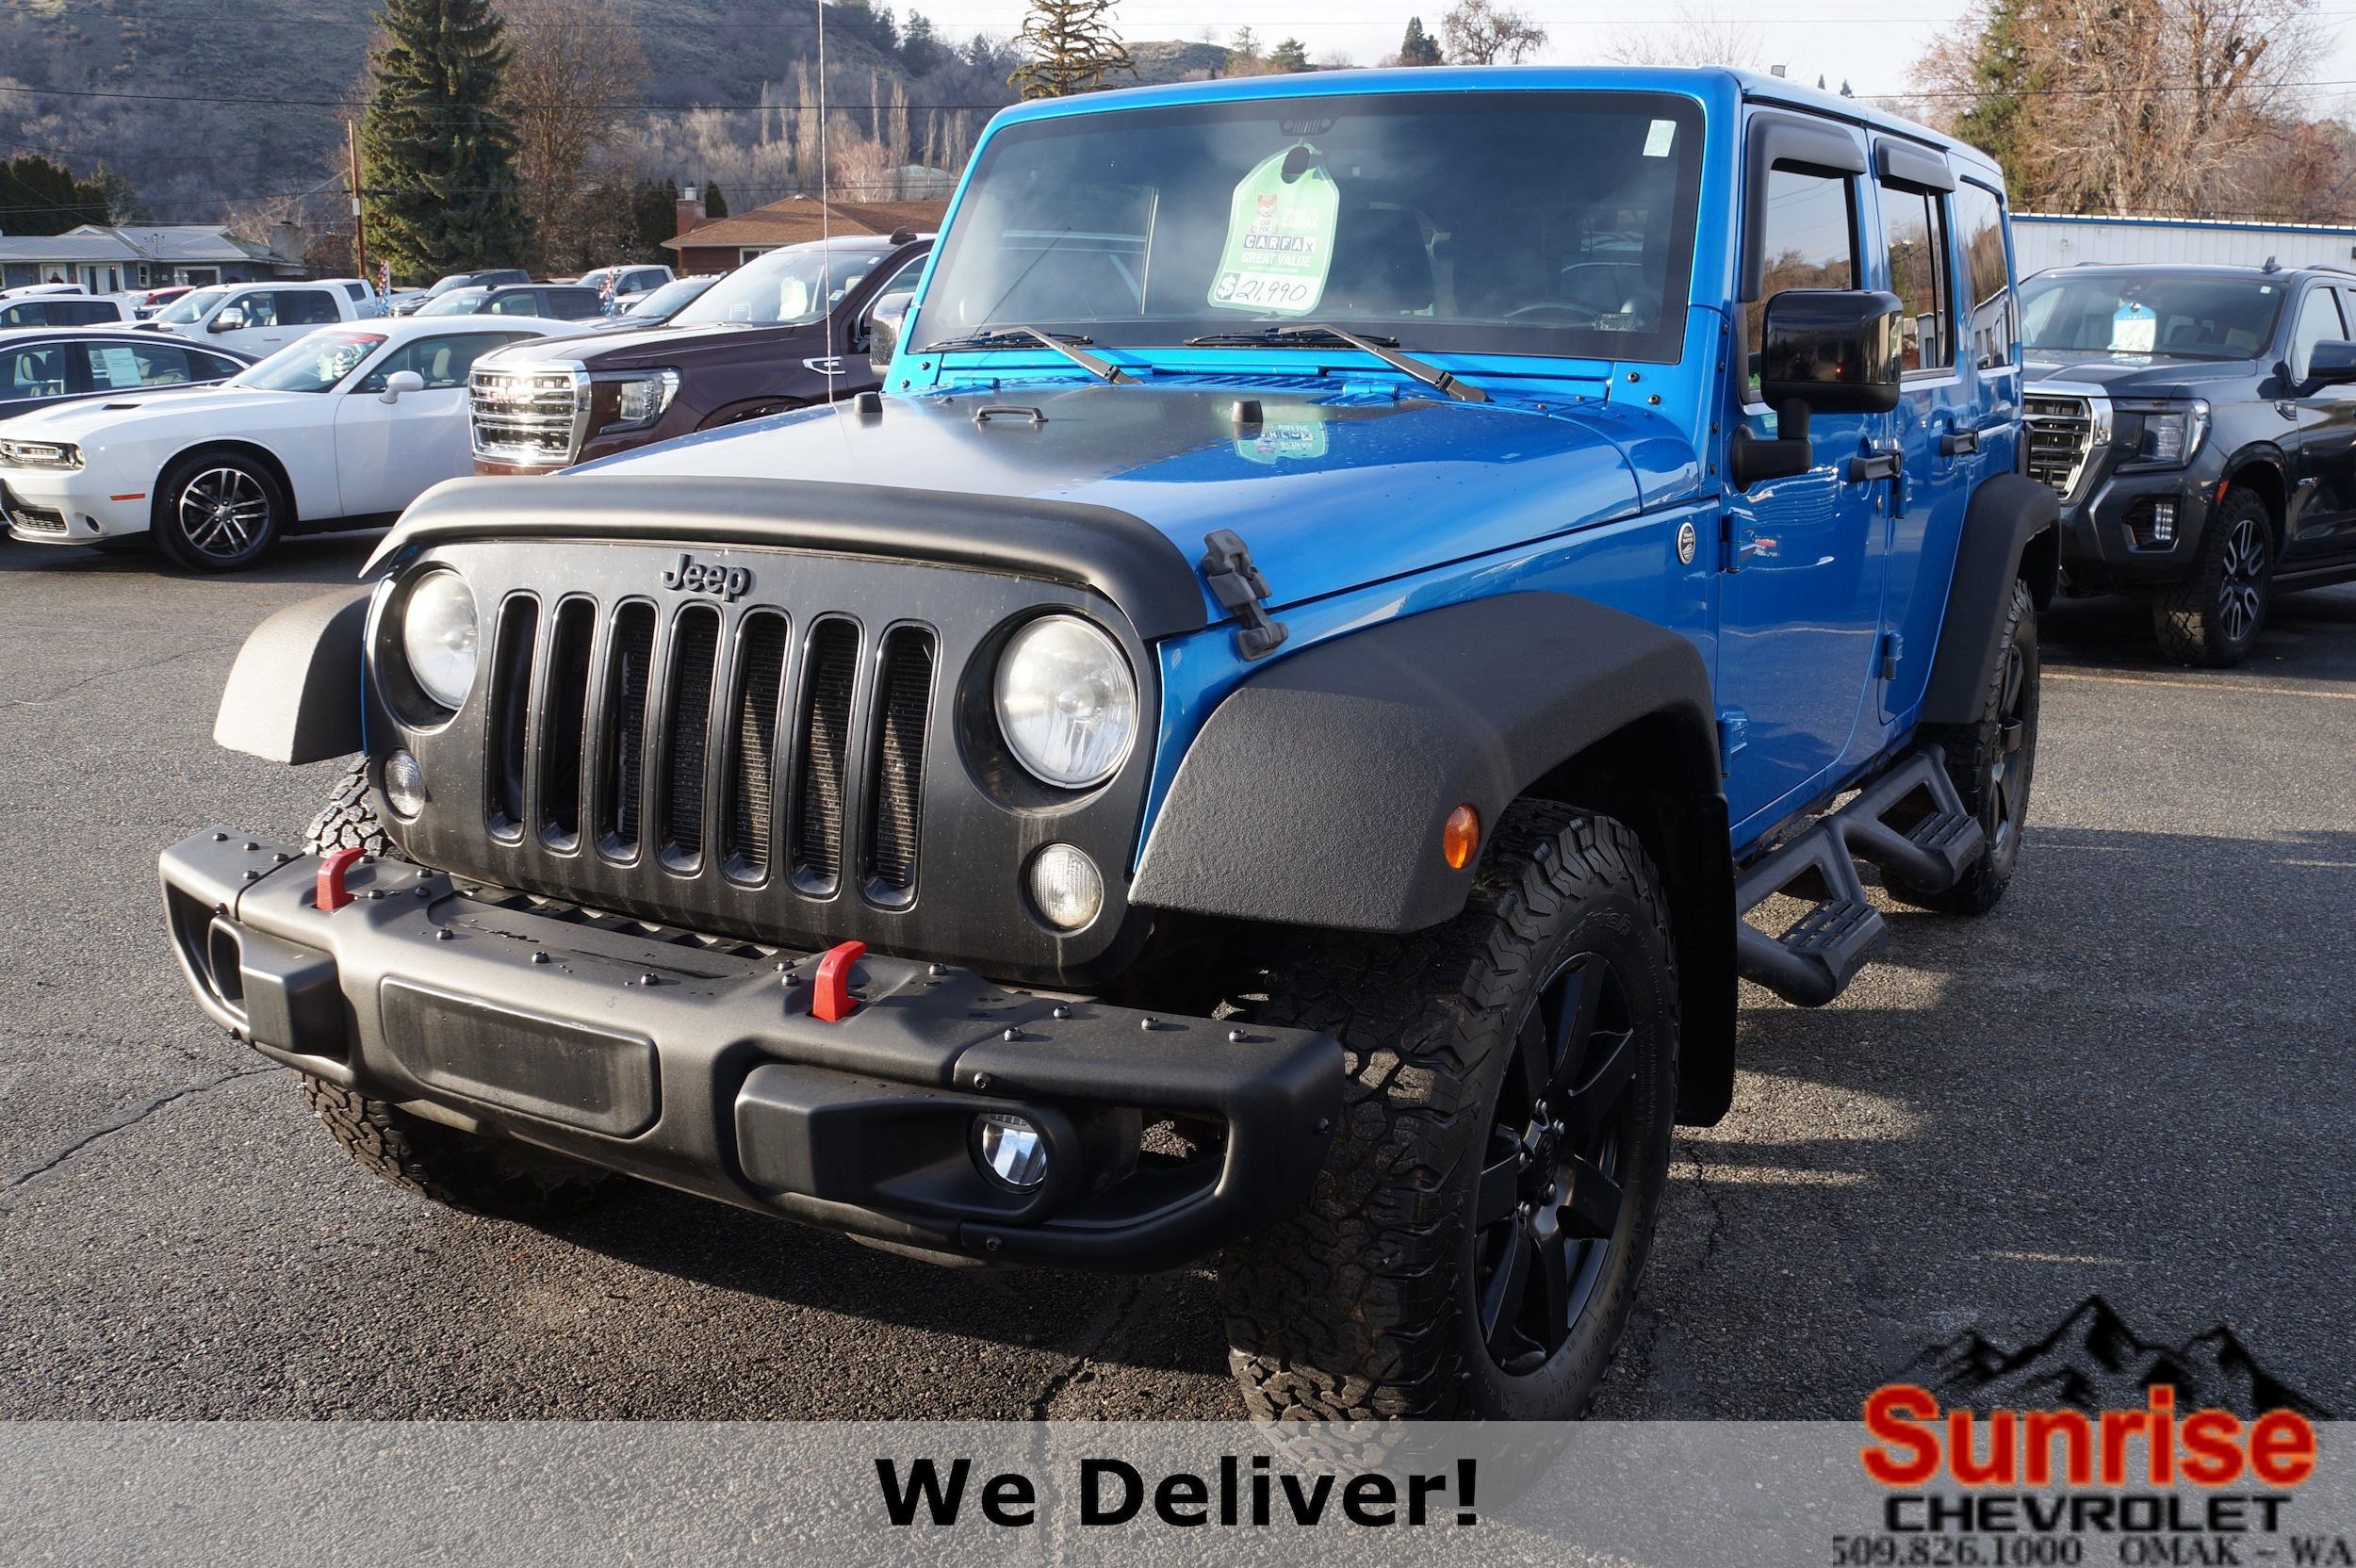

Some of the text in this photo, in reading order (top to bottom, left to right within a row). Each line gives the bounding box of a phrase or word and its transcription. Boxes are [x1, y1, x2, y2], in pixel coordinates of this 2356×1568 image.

[1243, 234, 1315, 253] CARFAX
[1241, 252, 1313, 268] GREAT VALUE
[661, 553, 752, 602] Jeep
